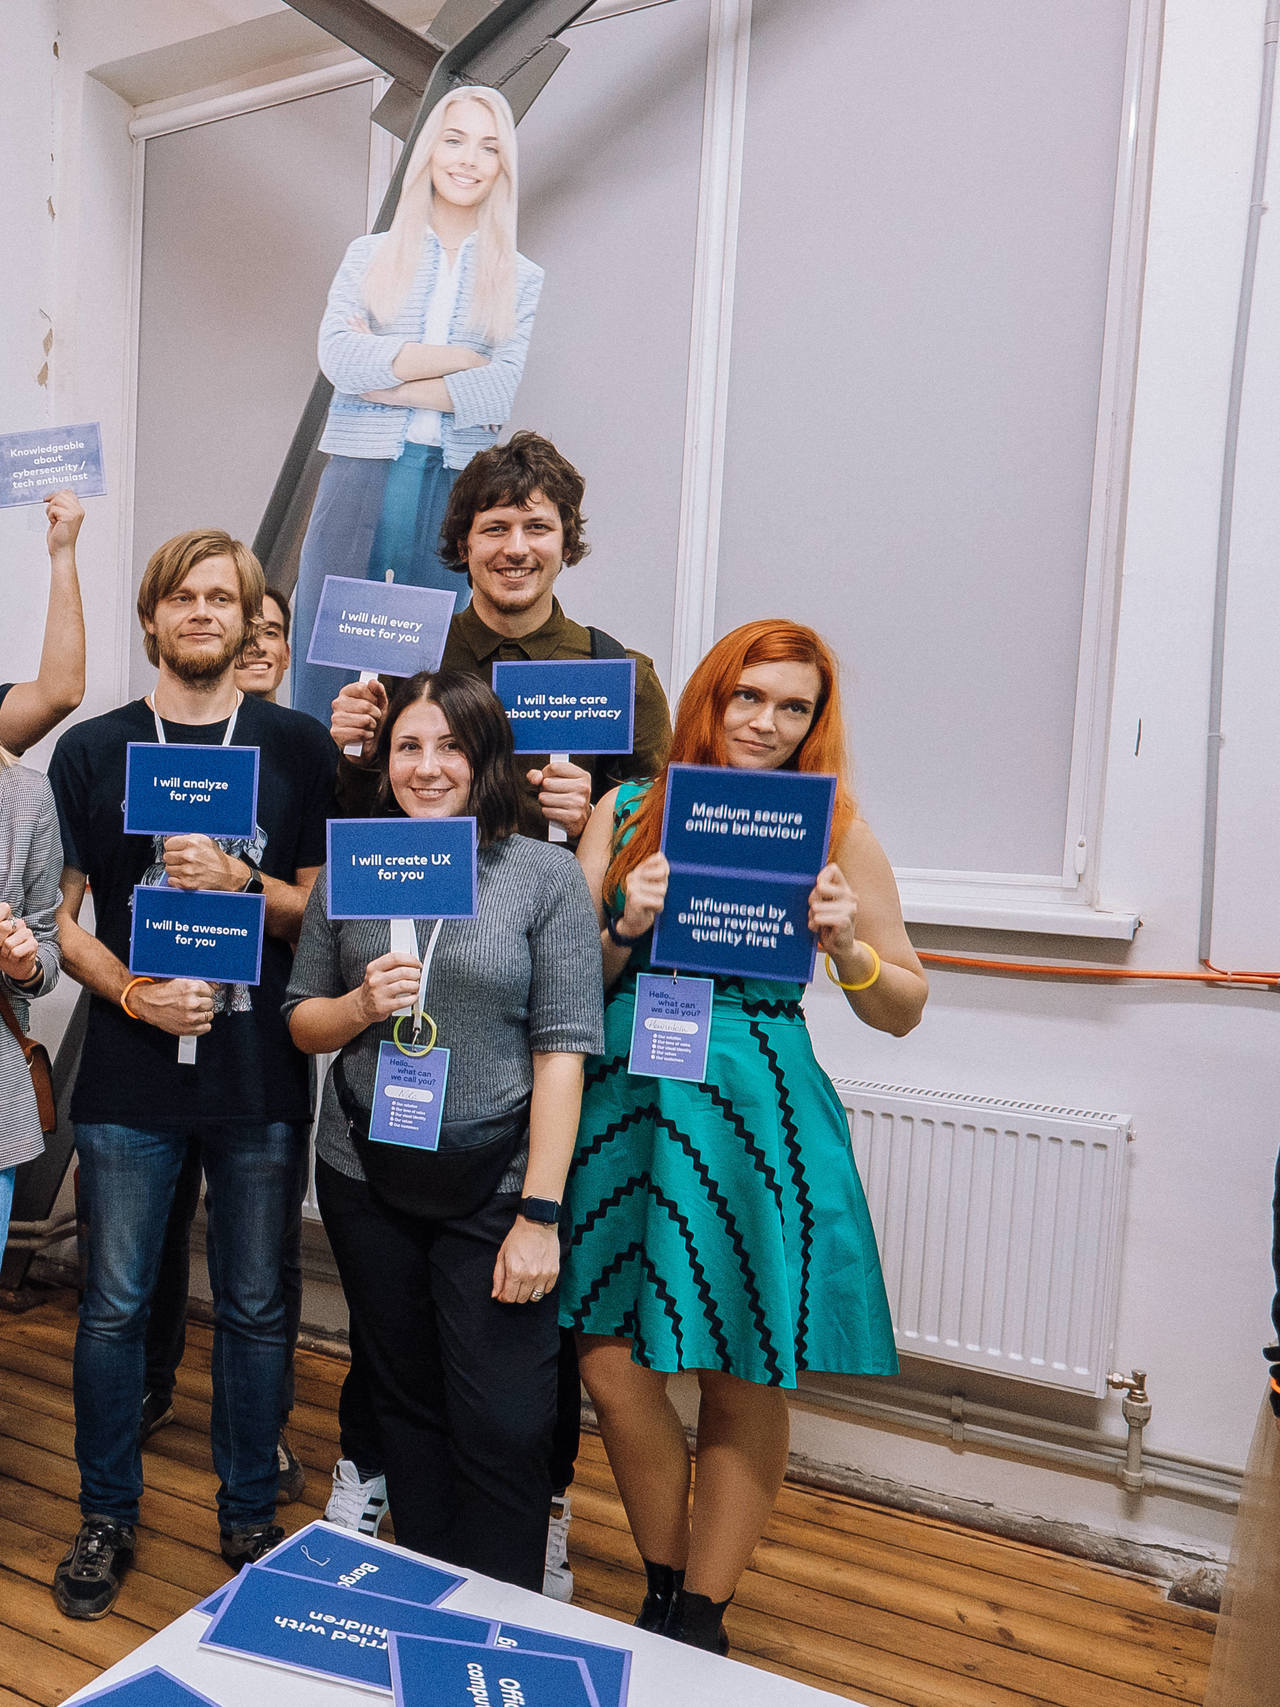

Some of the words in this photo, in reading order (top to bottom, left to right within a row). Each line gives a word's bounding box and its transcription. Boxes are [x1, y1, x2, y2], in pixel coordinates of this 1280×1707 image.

[10, 441, 85, 457] Knowledgeable
[33, 455, 63, 465] about
[12, 463, 78, 479] cybersecurity
[80, 460, 86, 470] /
[12, 478, 34, 488] tech
[36, 472, 88, 485] enthusiast
[341, 610, 346, 619] I
[348, 612, 368, 622] will
[370, 614, 387, 626] kill
[389, 618, 422, 632] every
[338, 623, 375, 638] threat
[378, 628, 395, 639] for
[397, 633, 420, 643] you
[517, 695, 521, 705] I
[523, 695, 545, 705] will
[548, 695, 577, 705] take
[579, 695, 607, 704] care
[505, 708, 541, 718] about
[543, 710, 571, 720] your
[574, 707, 621, 720] privacy
[153, 776, 157, 787] I
[160, 777, 181, 788] will
[183, 778, 229, 792] analyze
[169, 790, 187, 801] for
[190, 793, 211, 804] you
[691, 802, 750, 821] Medium
[754, 810, 803, 825] secure
[685, 819, 728, 834] online
[732, 821, 807, 840] behaviour
[351, 855, 356, 866] I
[358, 854, 382, 866] will
[384, 855, 428, 866] create
[431, 854, 451, 865] UX
[377, 869, 398, 880] for
[400, 871, 425, 882] you
[690, 896, 765, 918] Influenced
[768, 904, 787, 921] by
[145, 918, 149, 929] I
[152, 920, 173, 931] will
[175, 921, 190, 932] be
[191, 924, 248, 937] awesome
[678, 912, 721, 927] online
[724, 916, 780, 934] reviews
[783, 921, 795, 936] &
[175, 934, 192, 945] for
[195, 937, 216, 948] you
[691, 928, 742, 947] quality
[745, 932, 777, 949] first
[658, 999, 678, 1007] what
[680, 1001, 696, 1009] can
[665, 1007, 680, 1015] call
[681, 1009, 701, 1017] you?
[398, 1067, 416, 1076] what
[403, 1075, 417, 1083] call
[417, 1078, 437, 1086] you?
[274, 1615, 326, 1636] with
